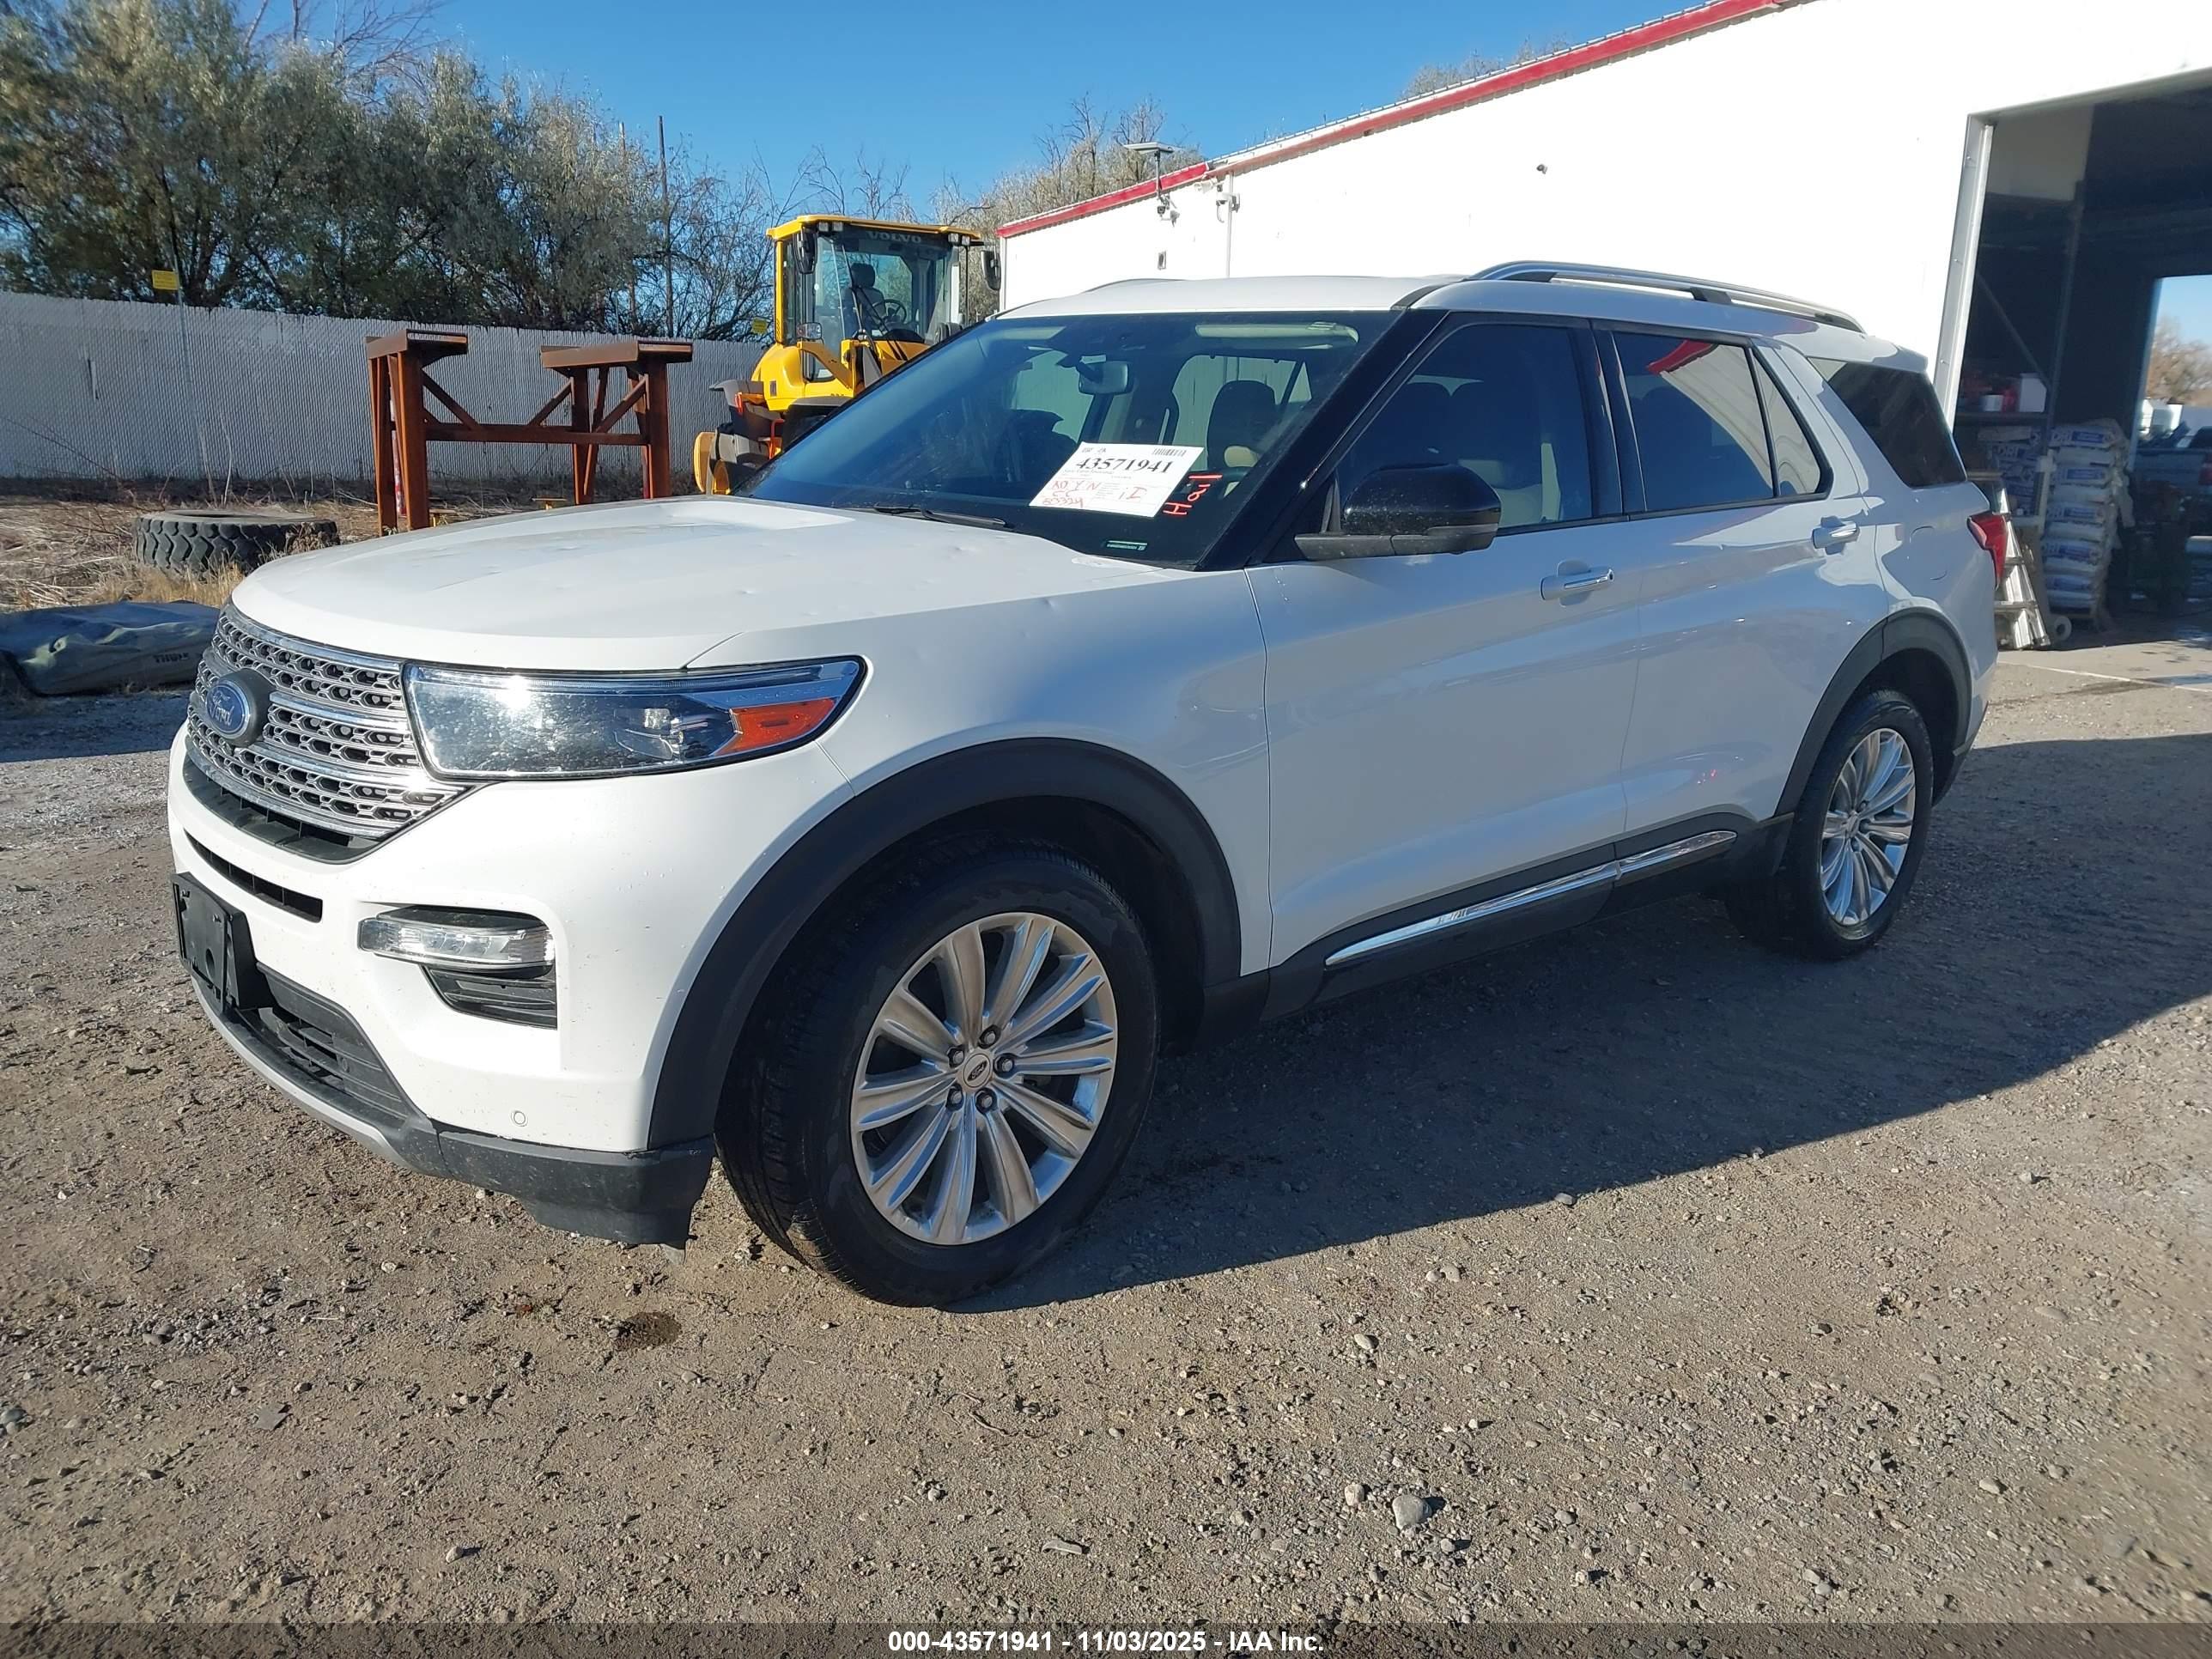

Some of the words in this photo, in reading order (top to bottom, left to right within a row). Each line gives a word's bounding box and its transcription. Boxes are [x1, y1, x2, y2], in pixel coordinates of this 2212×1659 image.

[866, 230, 922, 244] VOLVO
[1076, 457, 1174, 473] 43571941
[209, 690, 235, 726] Ford
